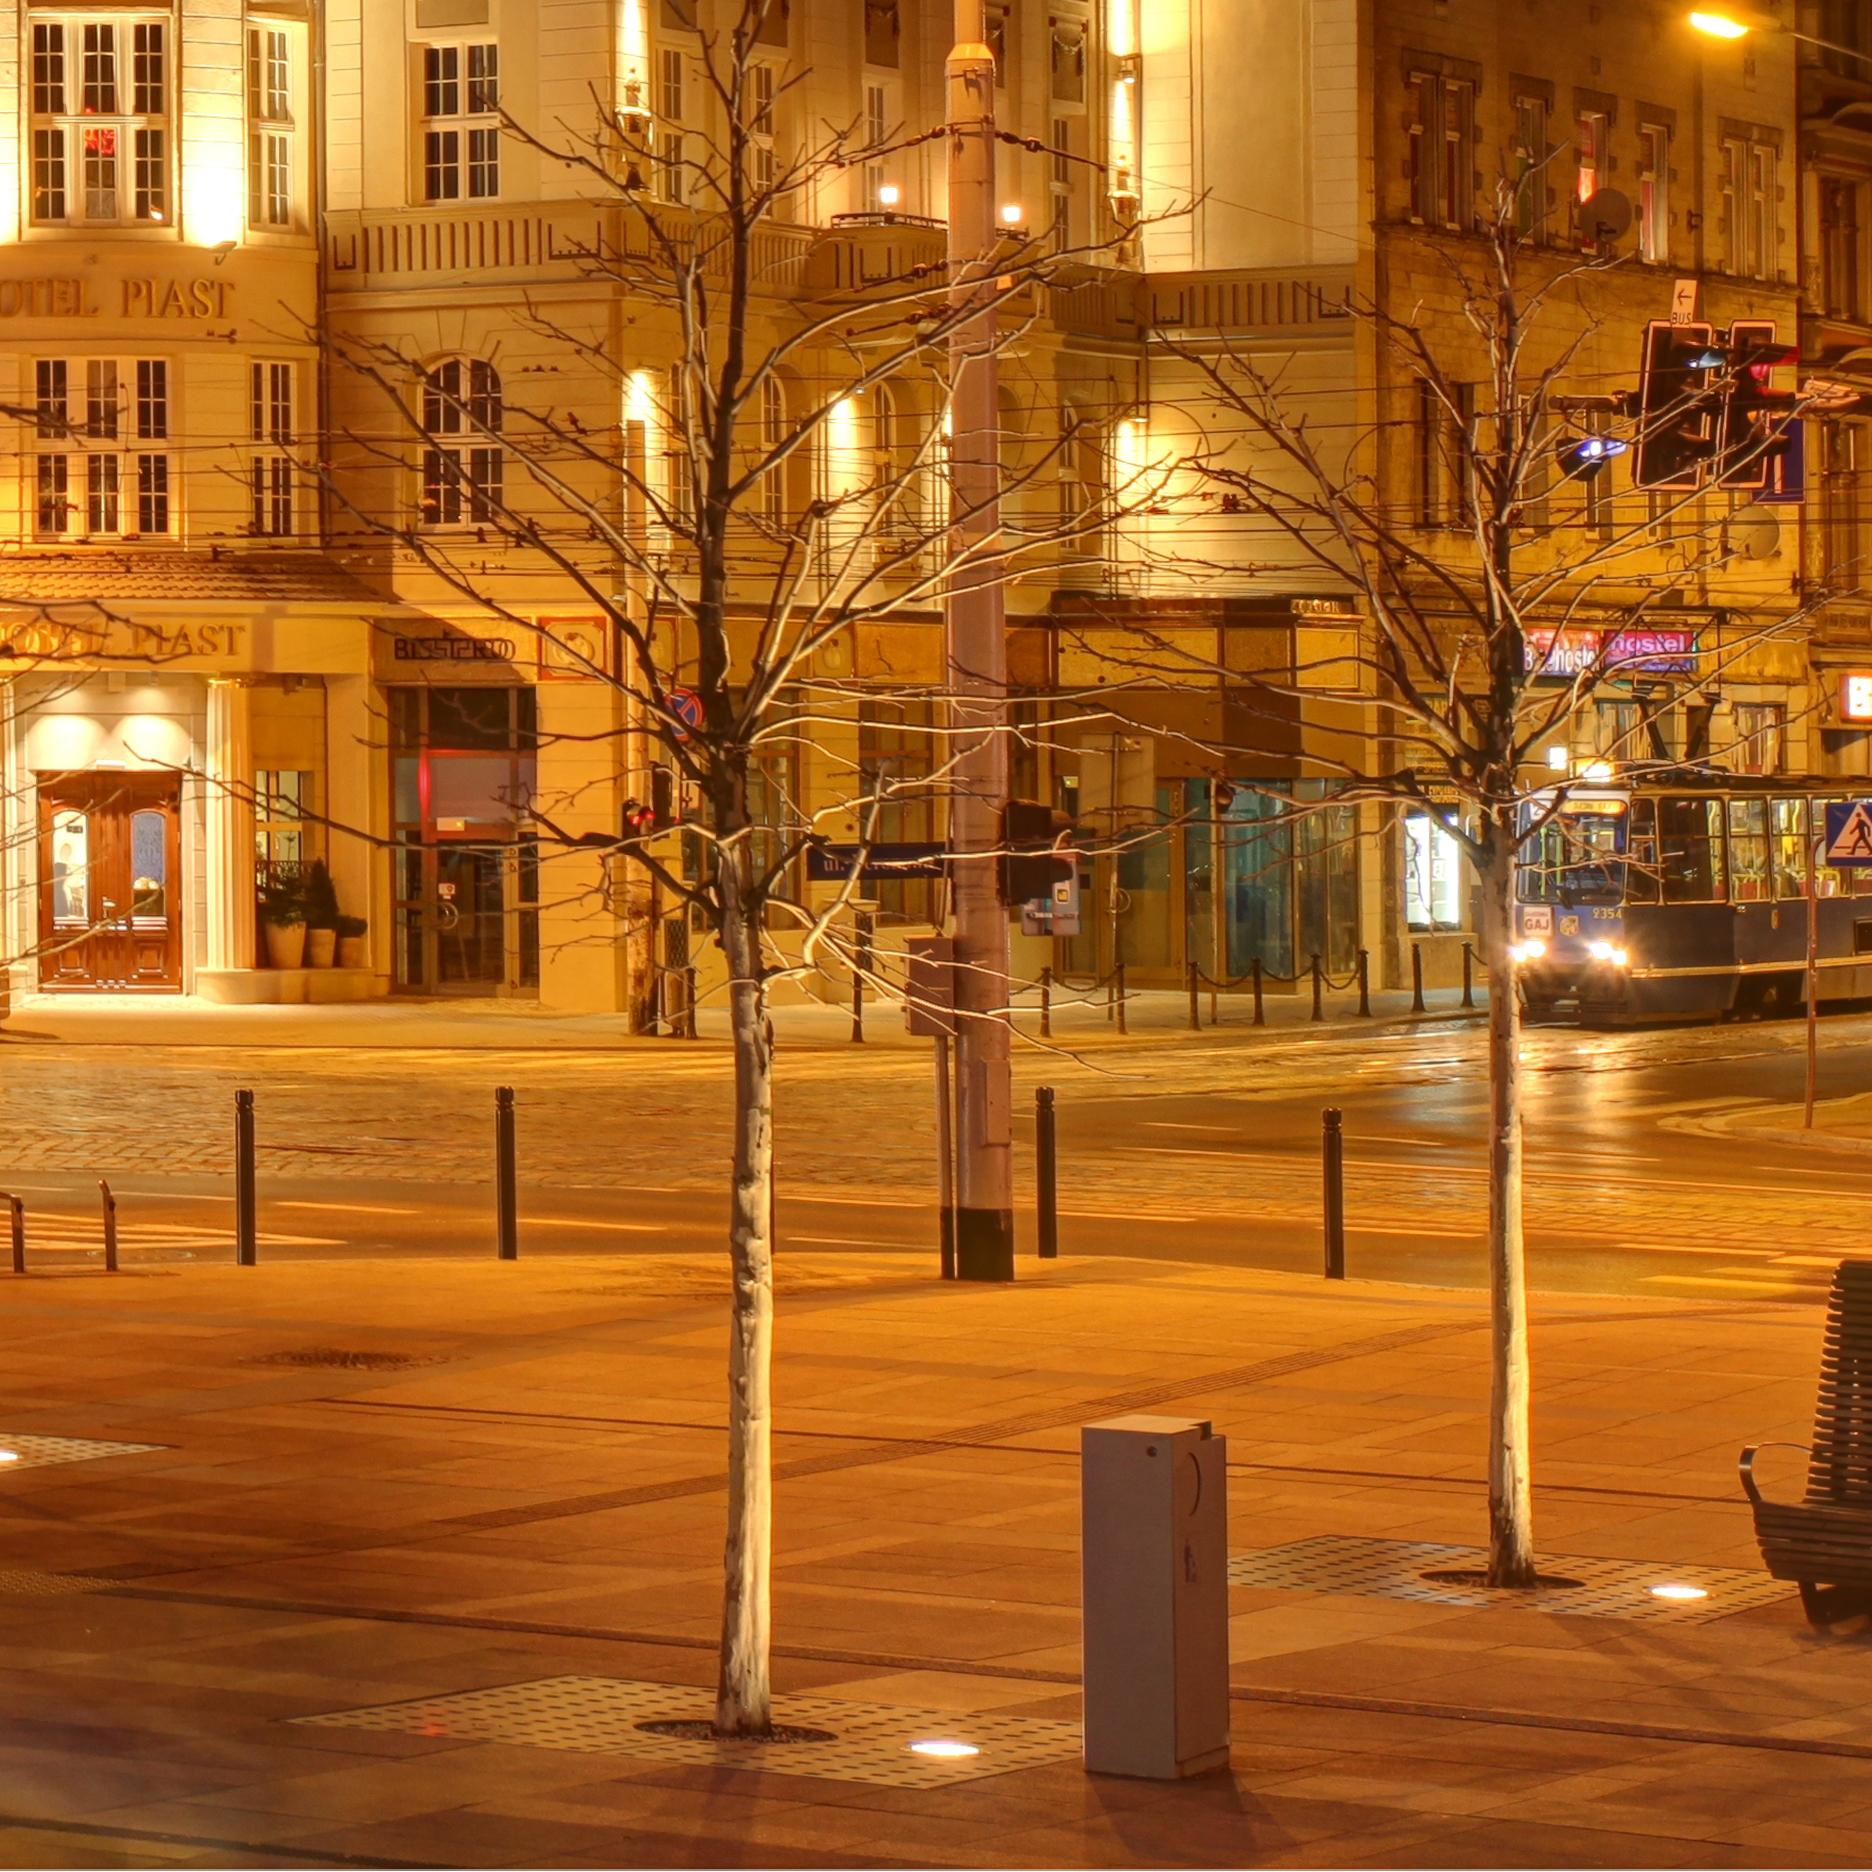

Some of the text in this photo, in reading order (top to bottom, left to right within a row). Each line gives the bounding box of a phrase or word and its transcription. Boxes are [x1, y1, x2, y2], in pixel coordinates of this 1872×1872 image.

[119, 278, 236, 318] PIAST
[1671, 312, 1692, 325] BUS
[132, 622, 246, 656] PIAST
[1609, 633, 1685, 653] hostel
[1592, 908, 1622, 919] 2354
[1524, 918, 1550, 930] GAJ
